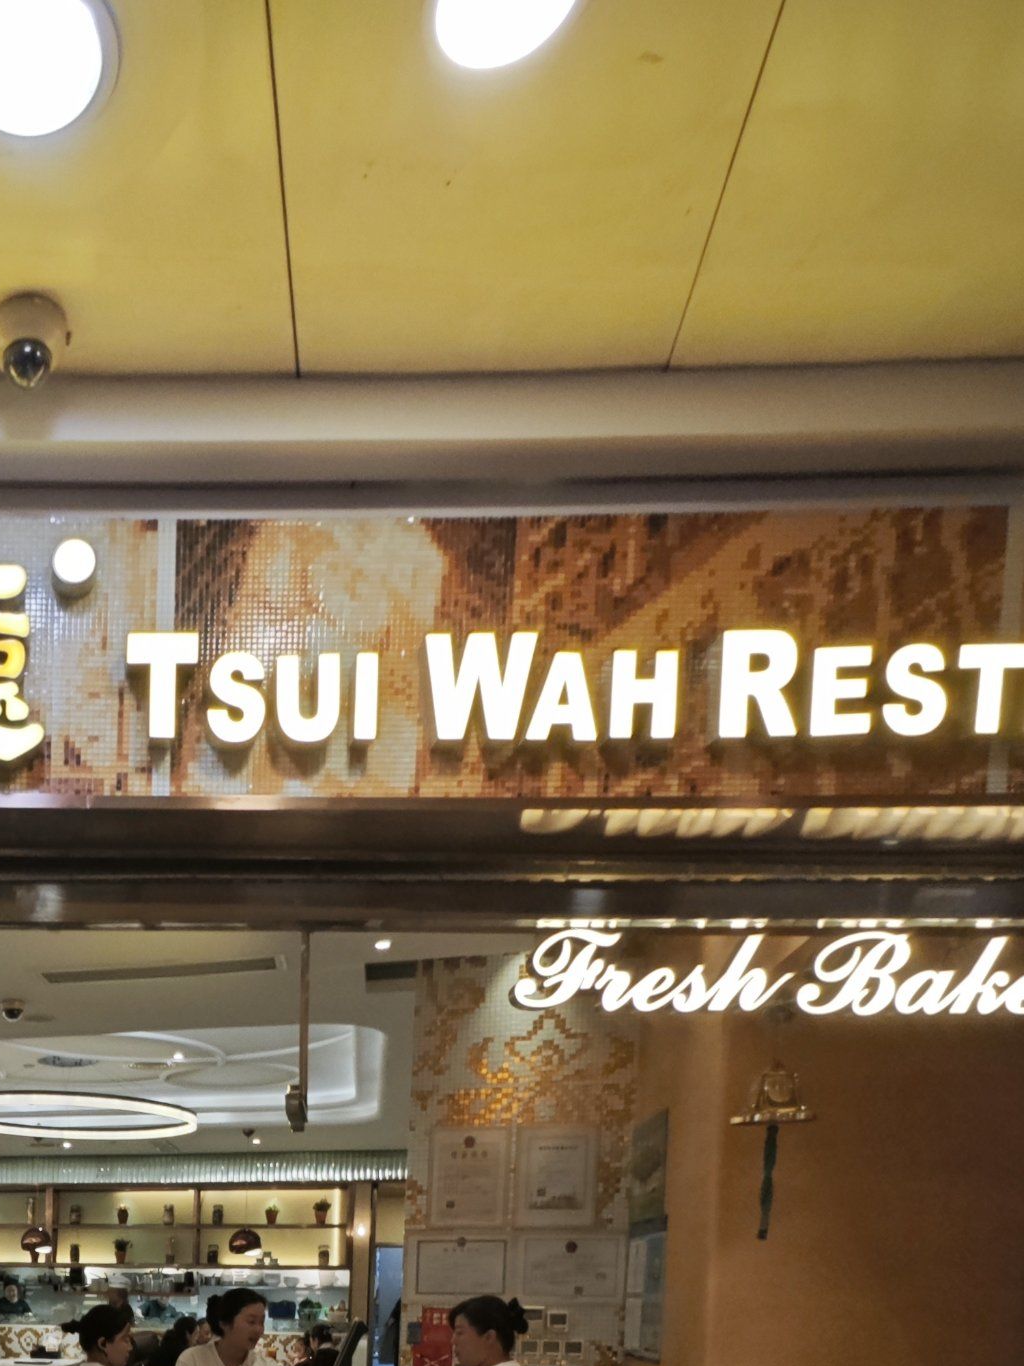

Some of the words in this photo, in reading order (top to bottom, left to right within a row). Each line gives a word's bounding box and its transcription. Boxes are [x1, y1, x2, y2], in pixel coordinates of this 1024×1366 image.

[126, 631, 380, 743] TSUI
[425, 631, 680, 740] WAH
[513, 927, 796, 1013] Fresh
